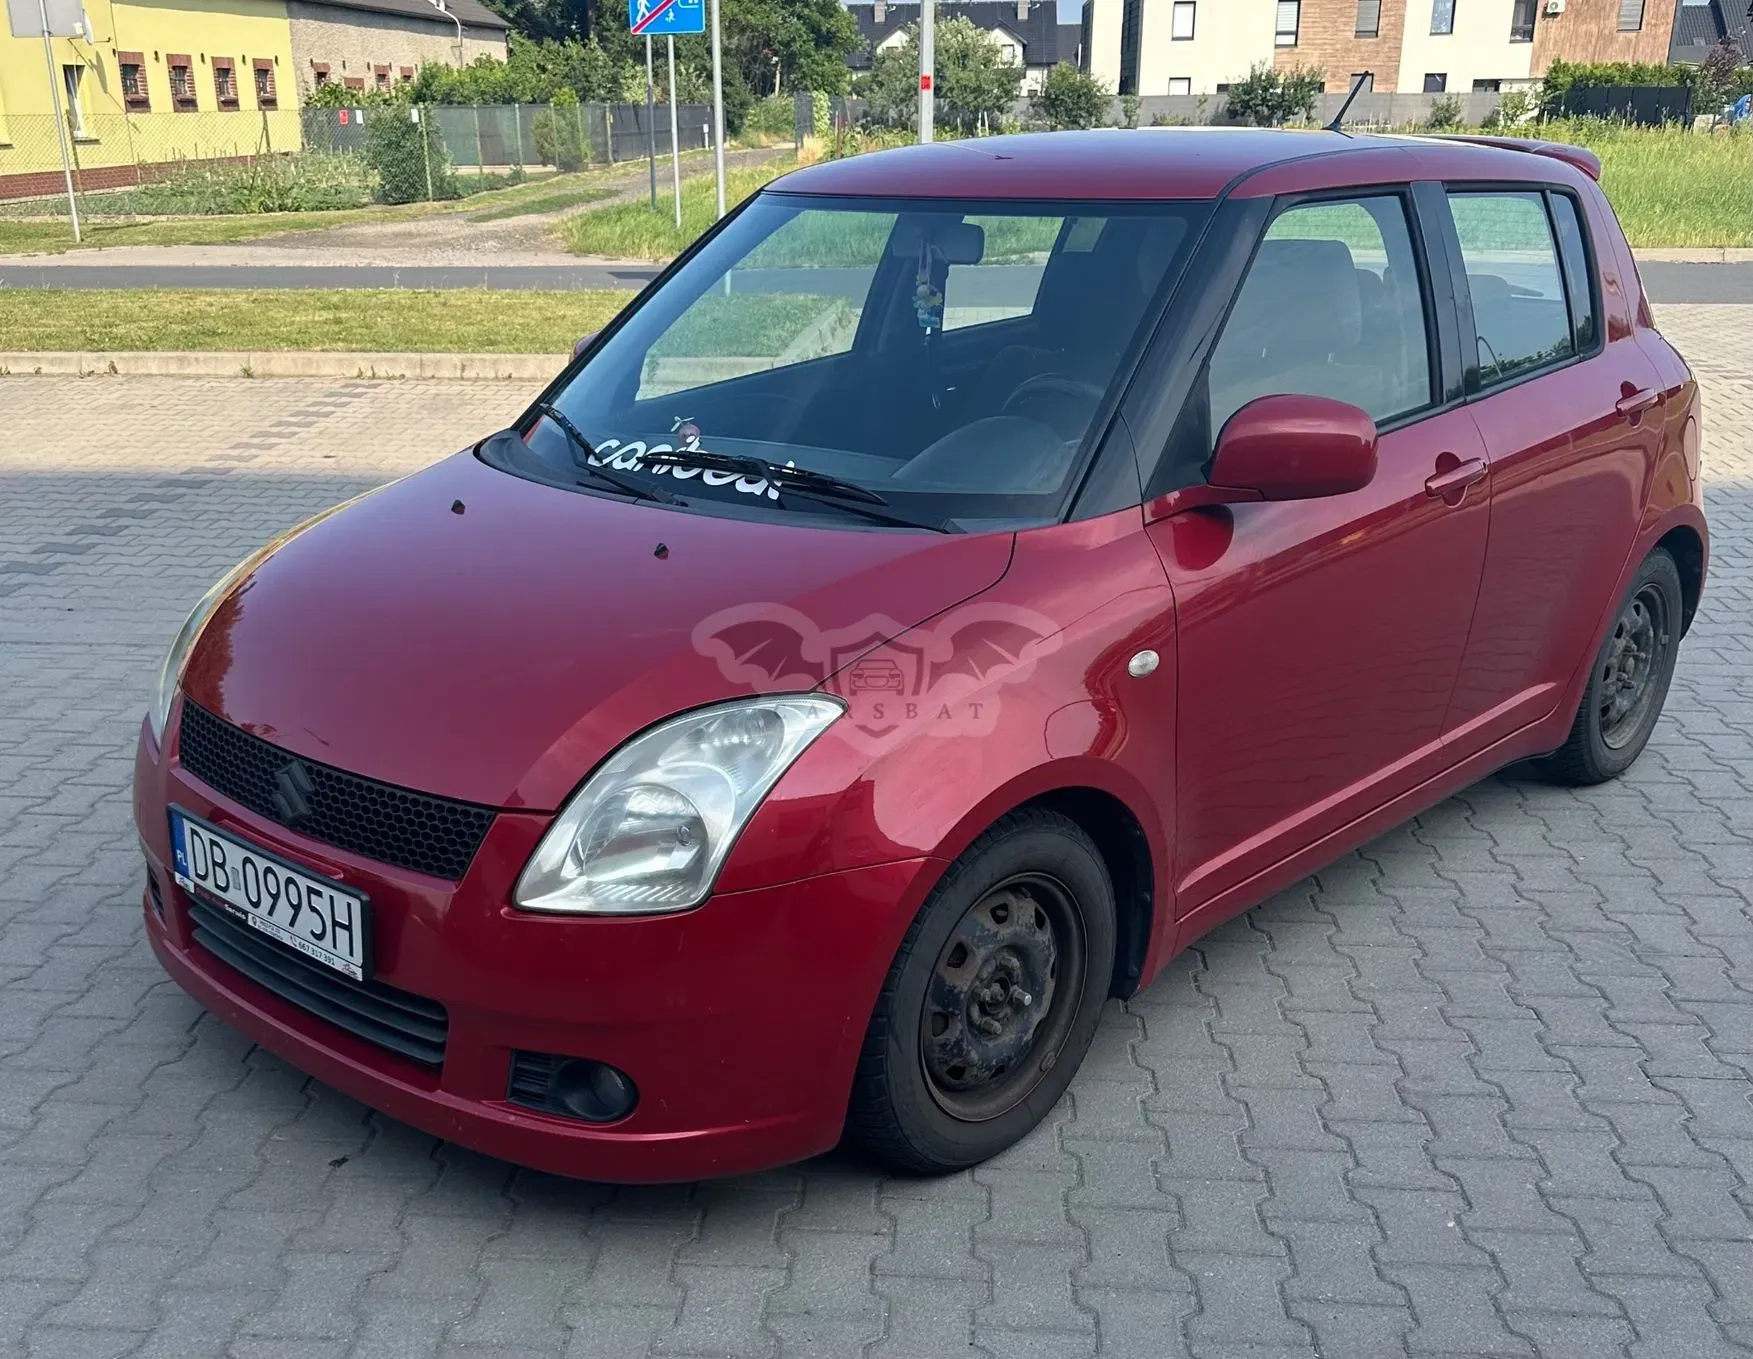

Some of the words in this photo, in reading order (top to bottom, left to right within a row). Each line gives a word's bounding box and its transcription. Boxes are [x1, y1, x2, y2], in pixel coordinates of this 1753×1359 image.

[176, 849, 187, 866] PL
[190, 827, 230, 893] DB
[242, 856, 354, 957] 0995H
